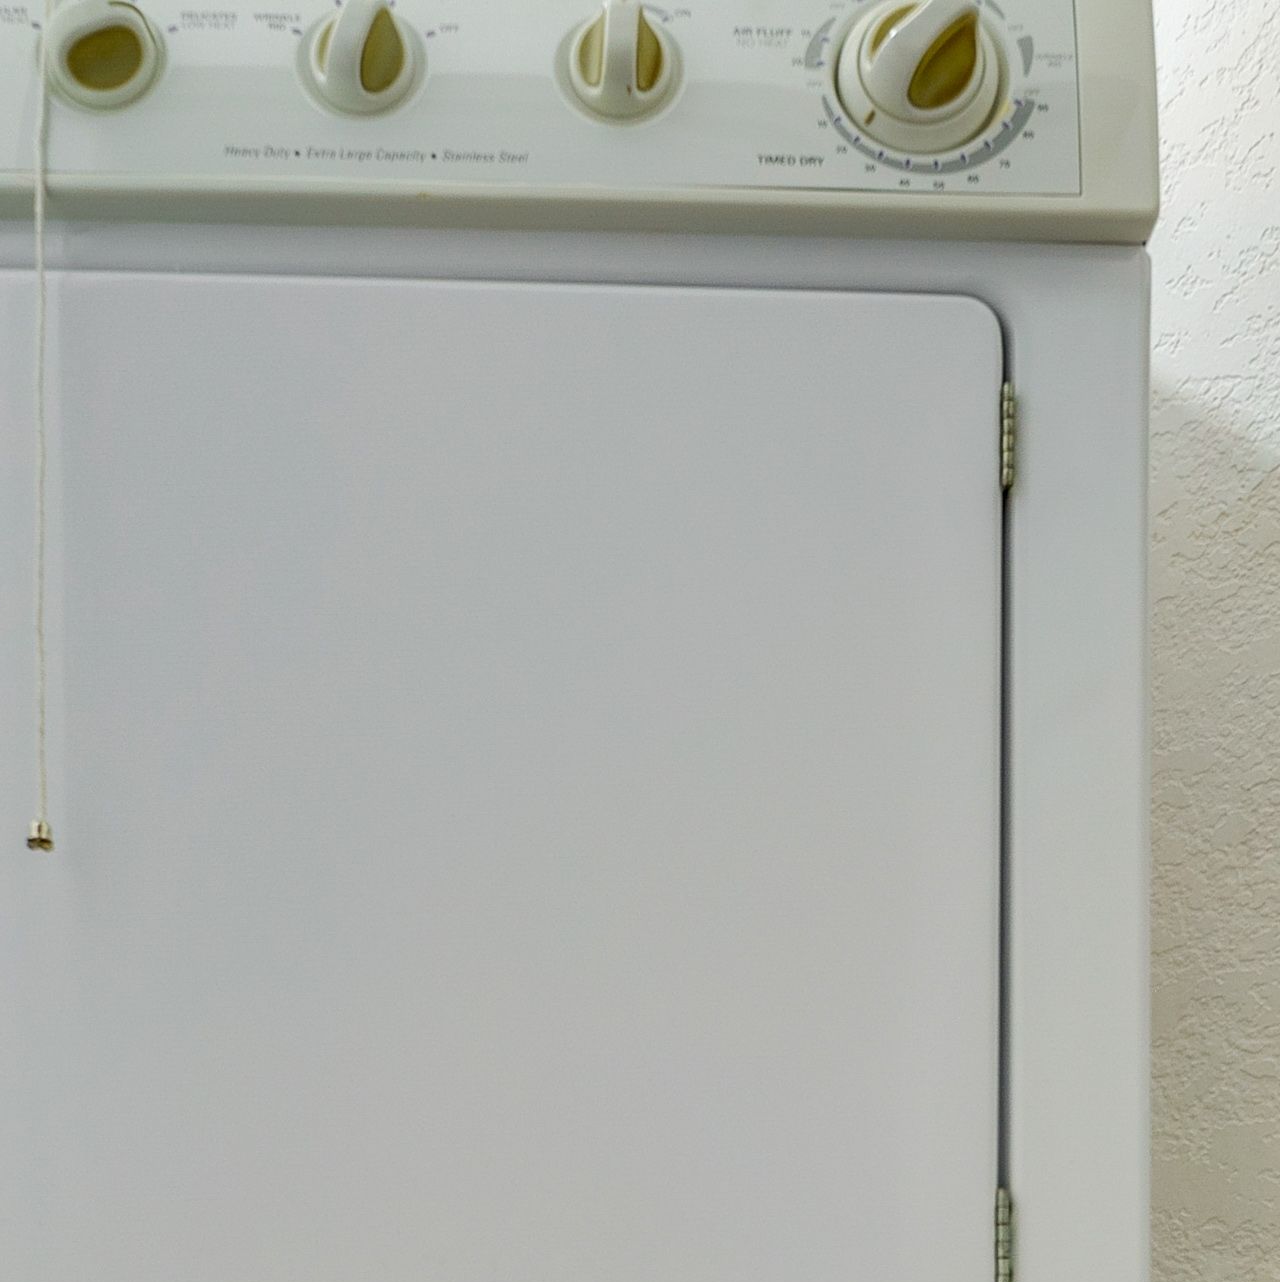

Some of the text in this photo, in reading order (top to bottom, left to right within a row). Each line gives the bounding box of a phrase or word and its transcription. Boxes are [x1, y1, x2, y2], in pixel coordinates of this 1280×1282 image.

[263, 146, 291, 160] Duty
[306, 147, 336, 159] Extra
[339, 147, 373, 162] Large
[375, 148, 426, 163] Capacity
[442, 149, 496, 163] Stainless
[498, 150, 529, 164] Steel
[758, 154, 825, 168] TIMED DRY
